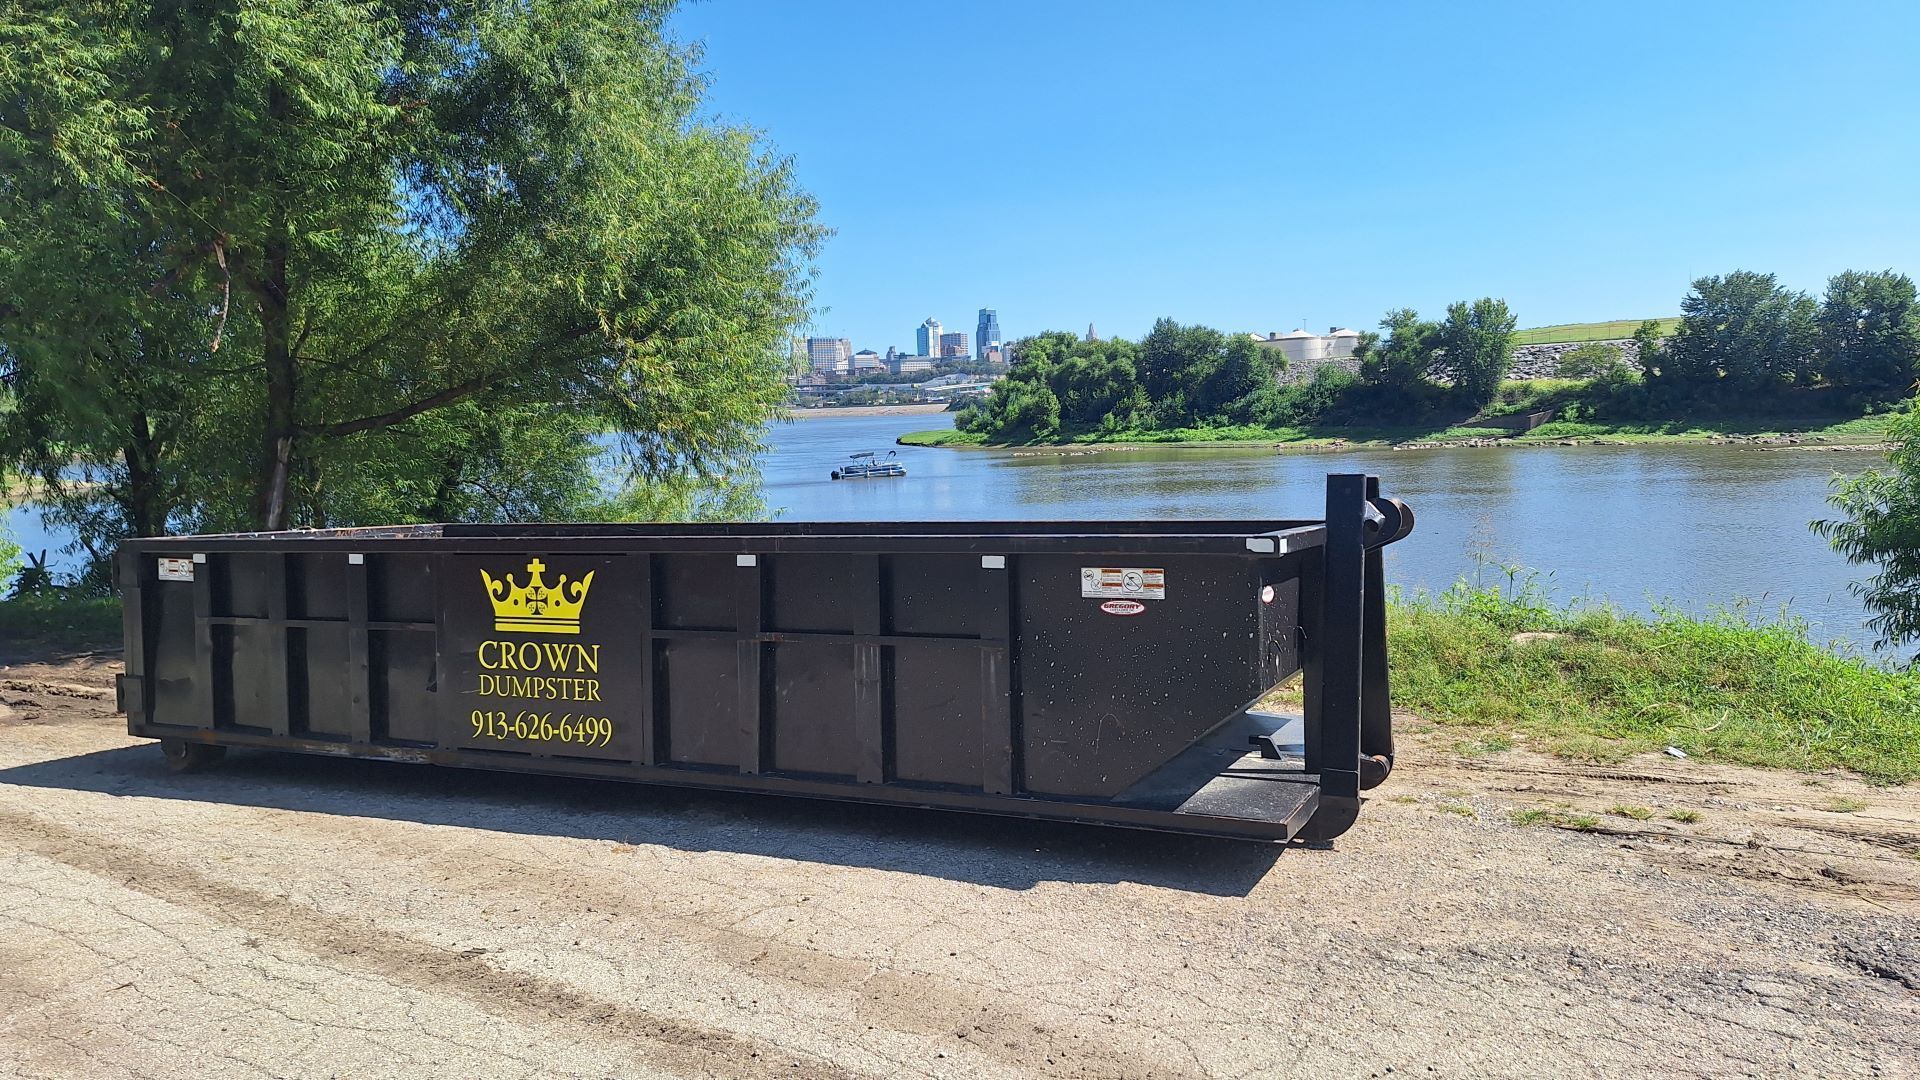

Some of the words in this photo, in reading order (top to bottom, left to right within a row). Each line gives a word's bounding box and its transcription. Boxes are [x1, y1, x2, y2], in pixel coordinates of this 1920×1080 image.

[478, 640, 600, 673] CROWN
[479, 674, 602, 702] DUMPSTER
[471, 710, 612, 747] 913-626-6499
